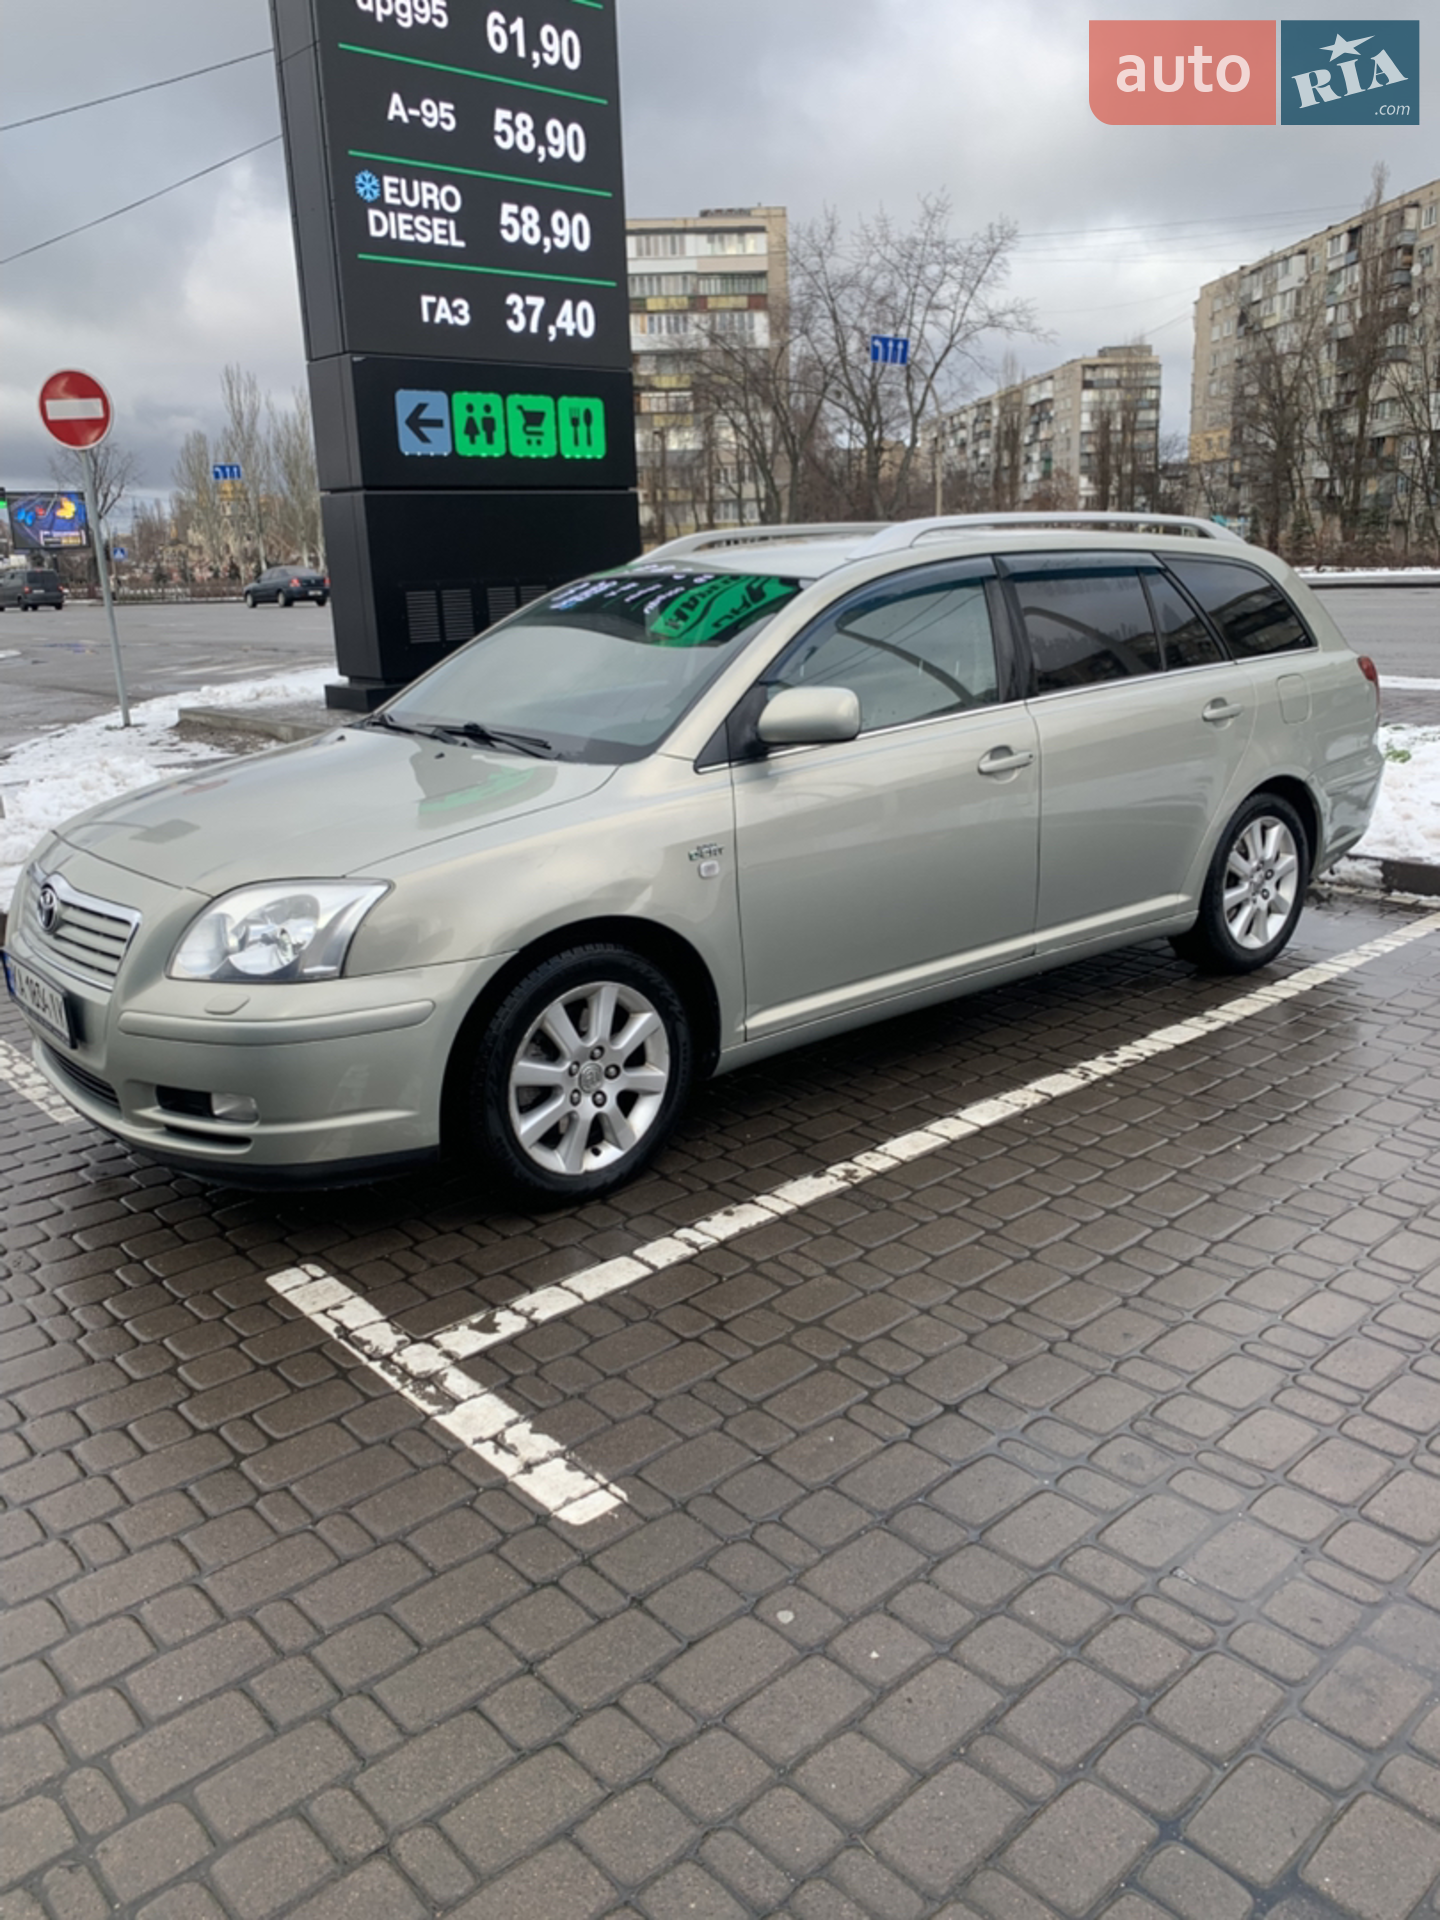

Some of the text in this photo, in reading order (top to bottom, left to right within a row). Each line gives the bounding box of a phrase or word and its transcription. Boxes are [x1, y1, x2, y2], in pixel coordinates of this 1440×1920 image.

[487, 11, 580, 69] 61,90
[494, 109, 585, 162] 58,90
[382, 175, 462, 213] EURO
[367, 208, 466, 248] DIESEL
[501, 203, 590, 253] 58,90
[421, 294, 594, 341] ГАЗ 37,40
